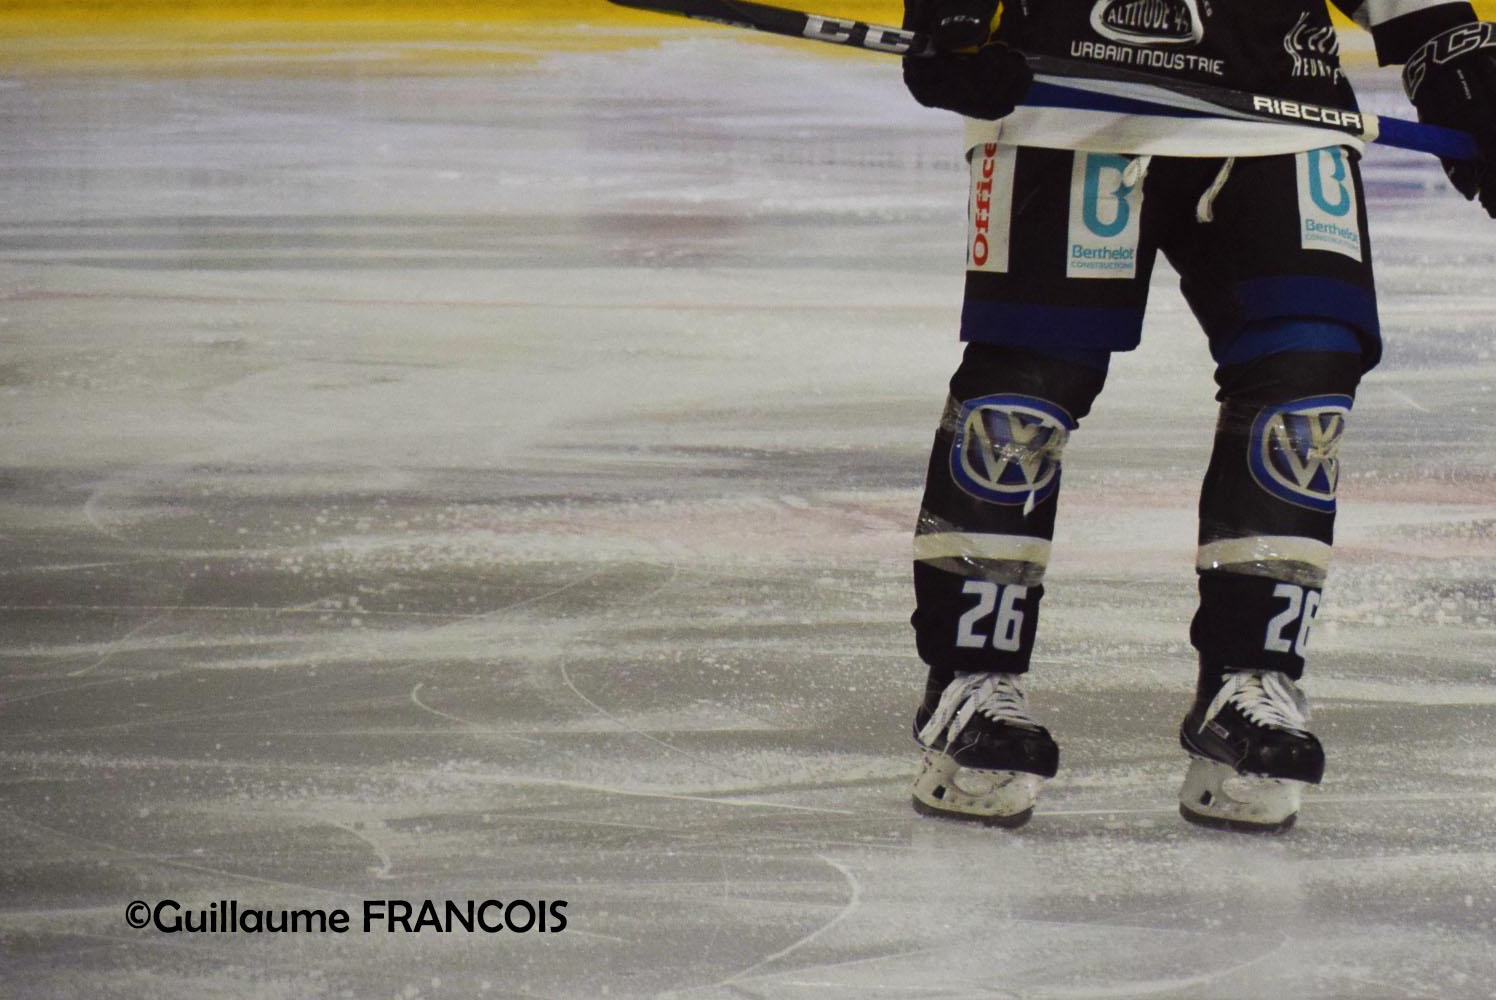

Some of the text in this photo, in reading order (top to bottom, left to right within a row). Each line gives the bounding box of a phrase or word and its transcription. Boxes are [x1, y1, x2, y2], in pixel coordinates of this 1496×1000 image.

[801, 14, 917, 55] CC
[1070, 40, 1225, 76] URBAIN INDUSTRIE
[1252, 95, 1362, 130] RIBCOR
[973, 142, 997, 266] Office
[955, 580, 1027, 653] 26
